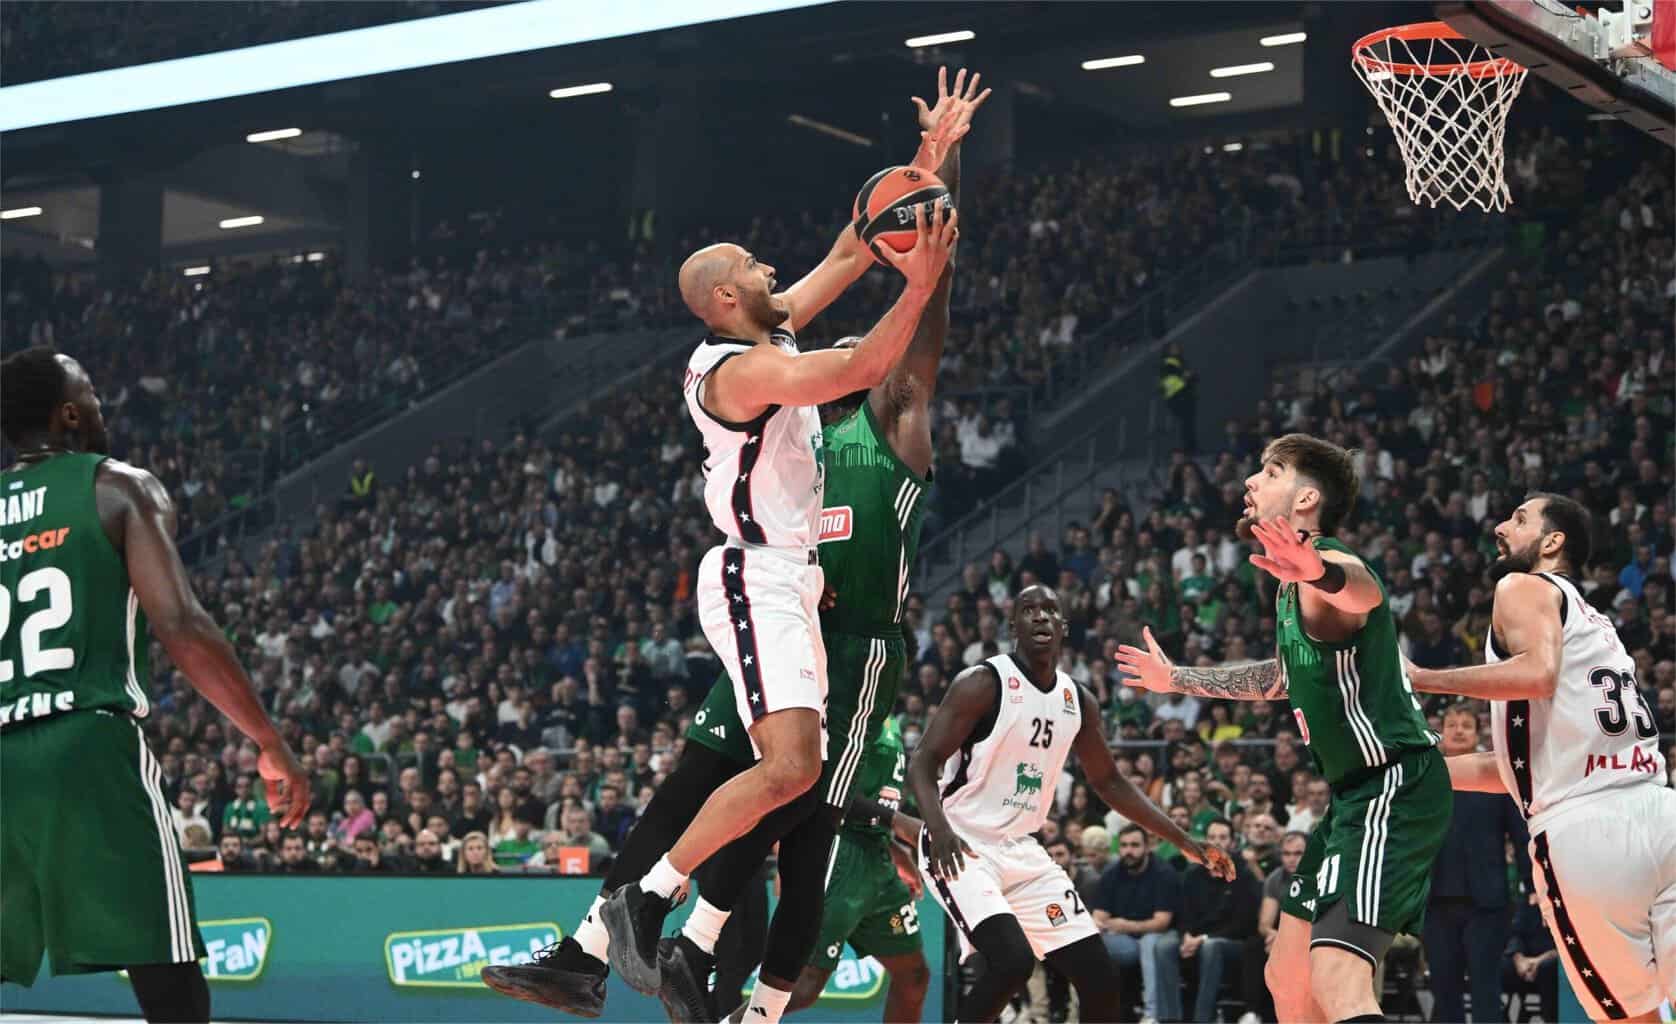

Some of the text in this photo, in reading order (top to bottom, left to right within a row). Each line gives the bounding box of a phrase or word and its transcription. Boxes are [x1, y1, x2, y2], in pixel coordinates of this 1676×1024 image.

[1029, 717, 1054, 749] 25
[1064, 889, 1085, 915] 2
[206, 926, 266, 977] FaN
